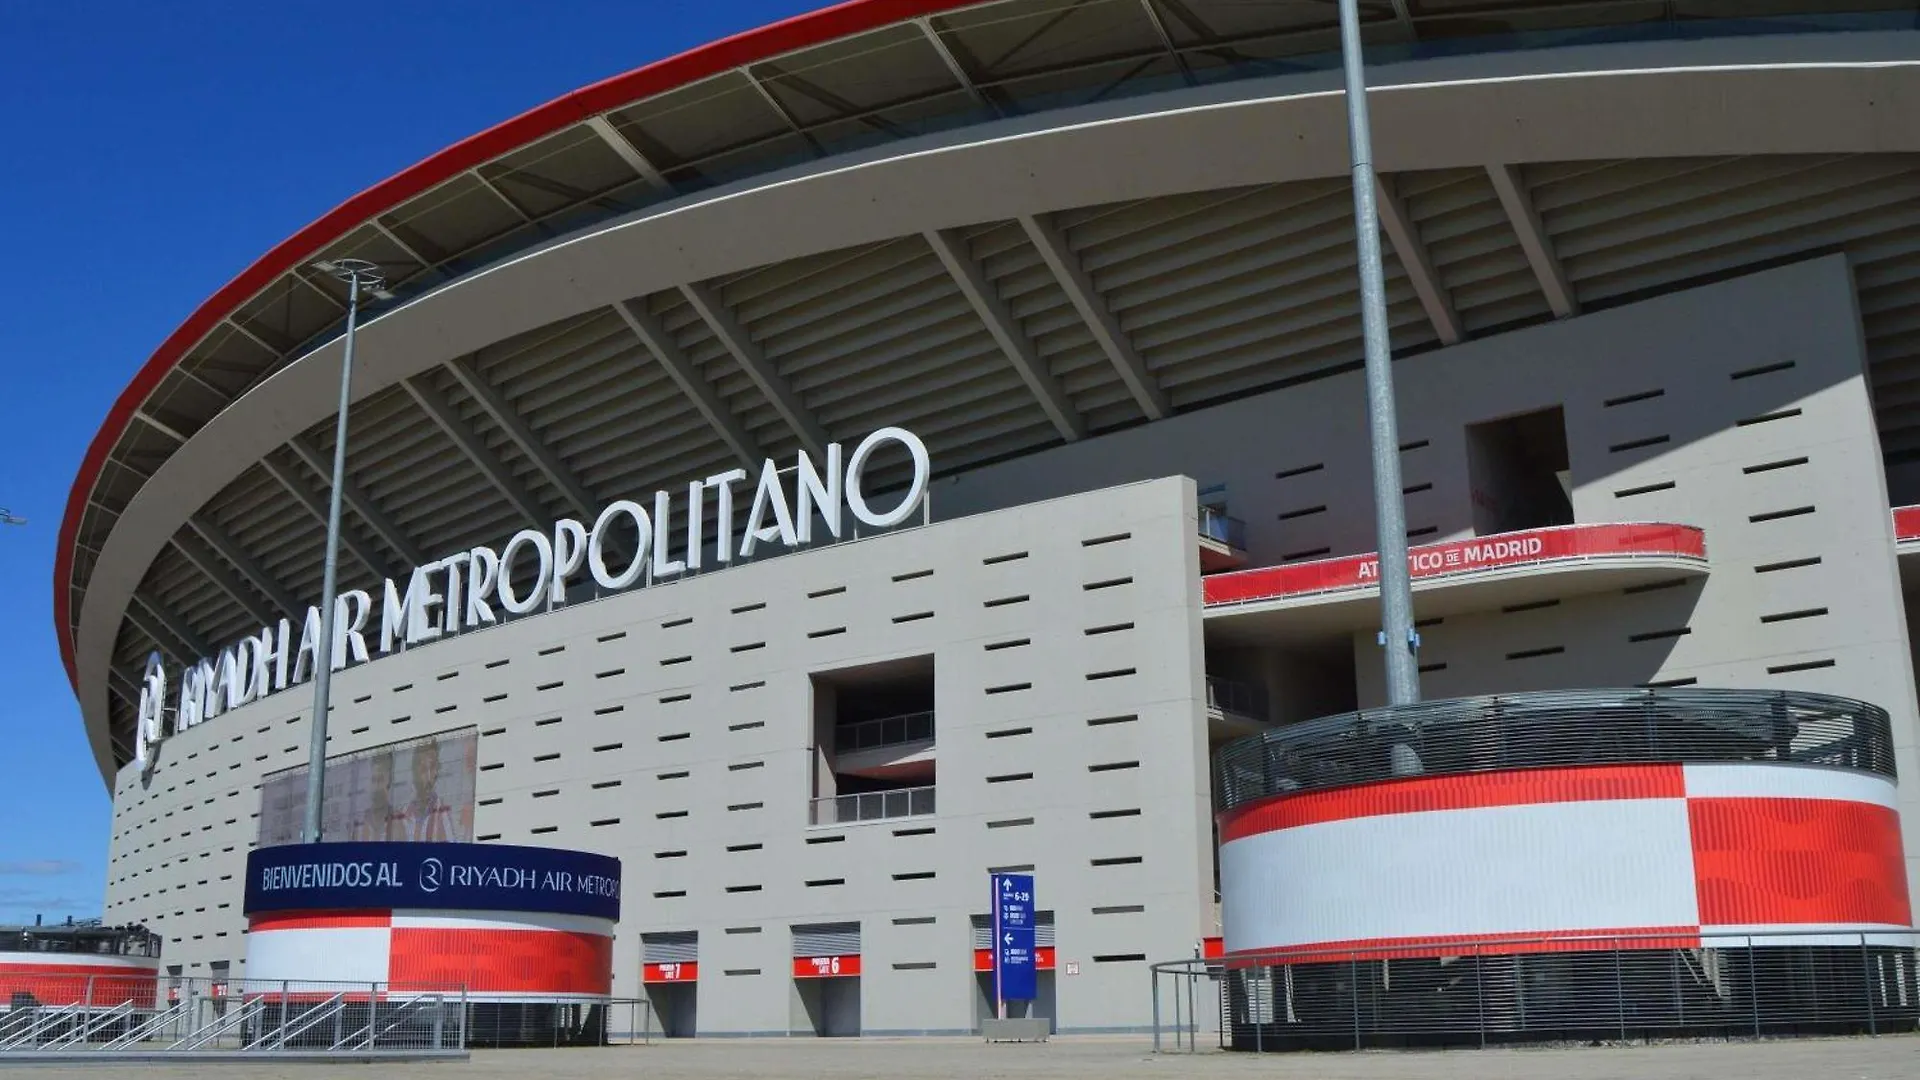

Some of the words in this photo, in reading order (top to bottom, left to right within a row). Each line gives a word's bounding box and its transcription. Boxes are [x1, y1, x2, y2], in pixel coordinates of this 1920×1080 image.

[1358, 553, 1442, 579] ATICO
[1446, 552, 1459, 562] DE
[1464, 537, 1542, 563] MADRID
[178, 618, 290, 731] RIYADH
[292, 589, 372, 684] AR
[380, 427, 930, 652] METROPOLITANO
[262, 862, 373, 891] BIENVENIDOS
[376, 862, 403, 887] AL
[450, 865, 535, 889] RIYADH
[541, 871, 572, 892] AIR
[675, 963, 680, 979] 7
[831, 956, 839, 974] 6
